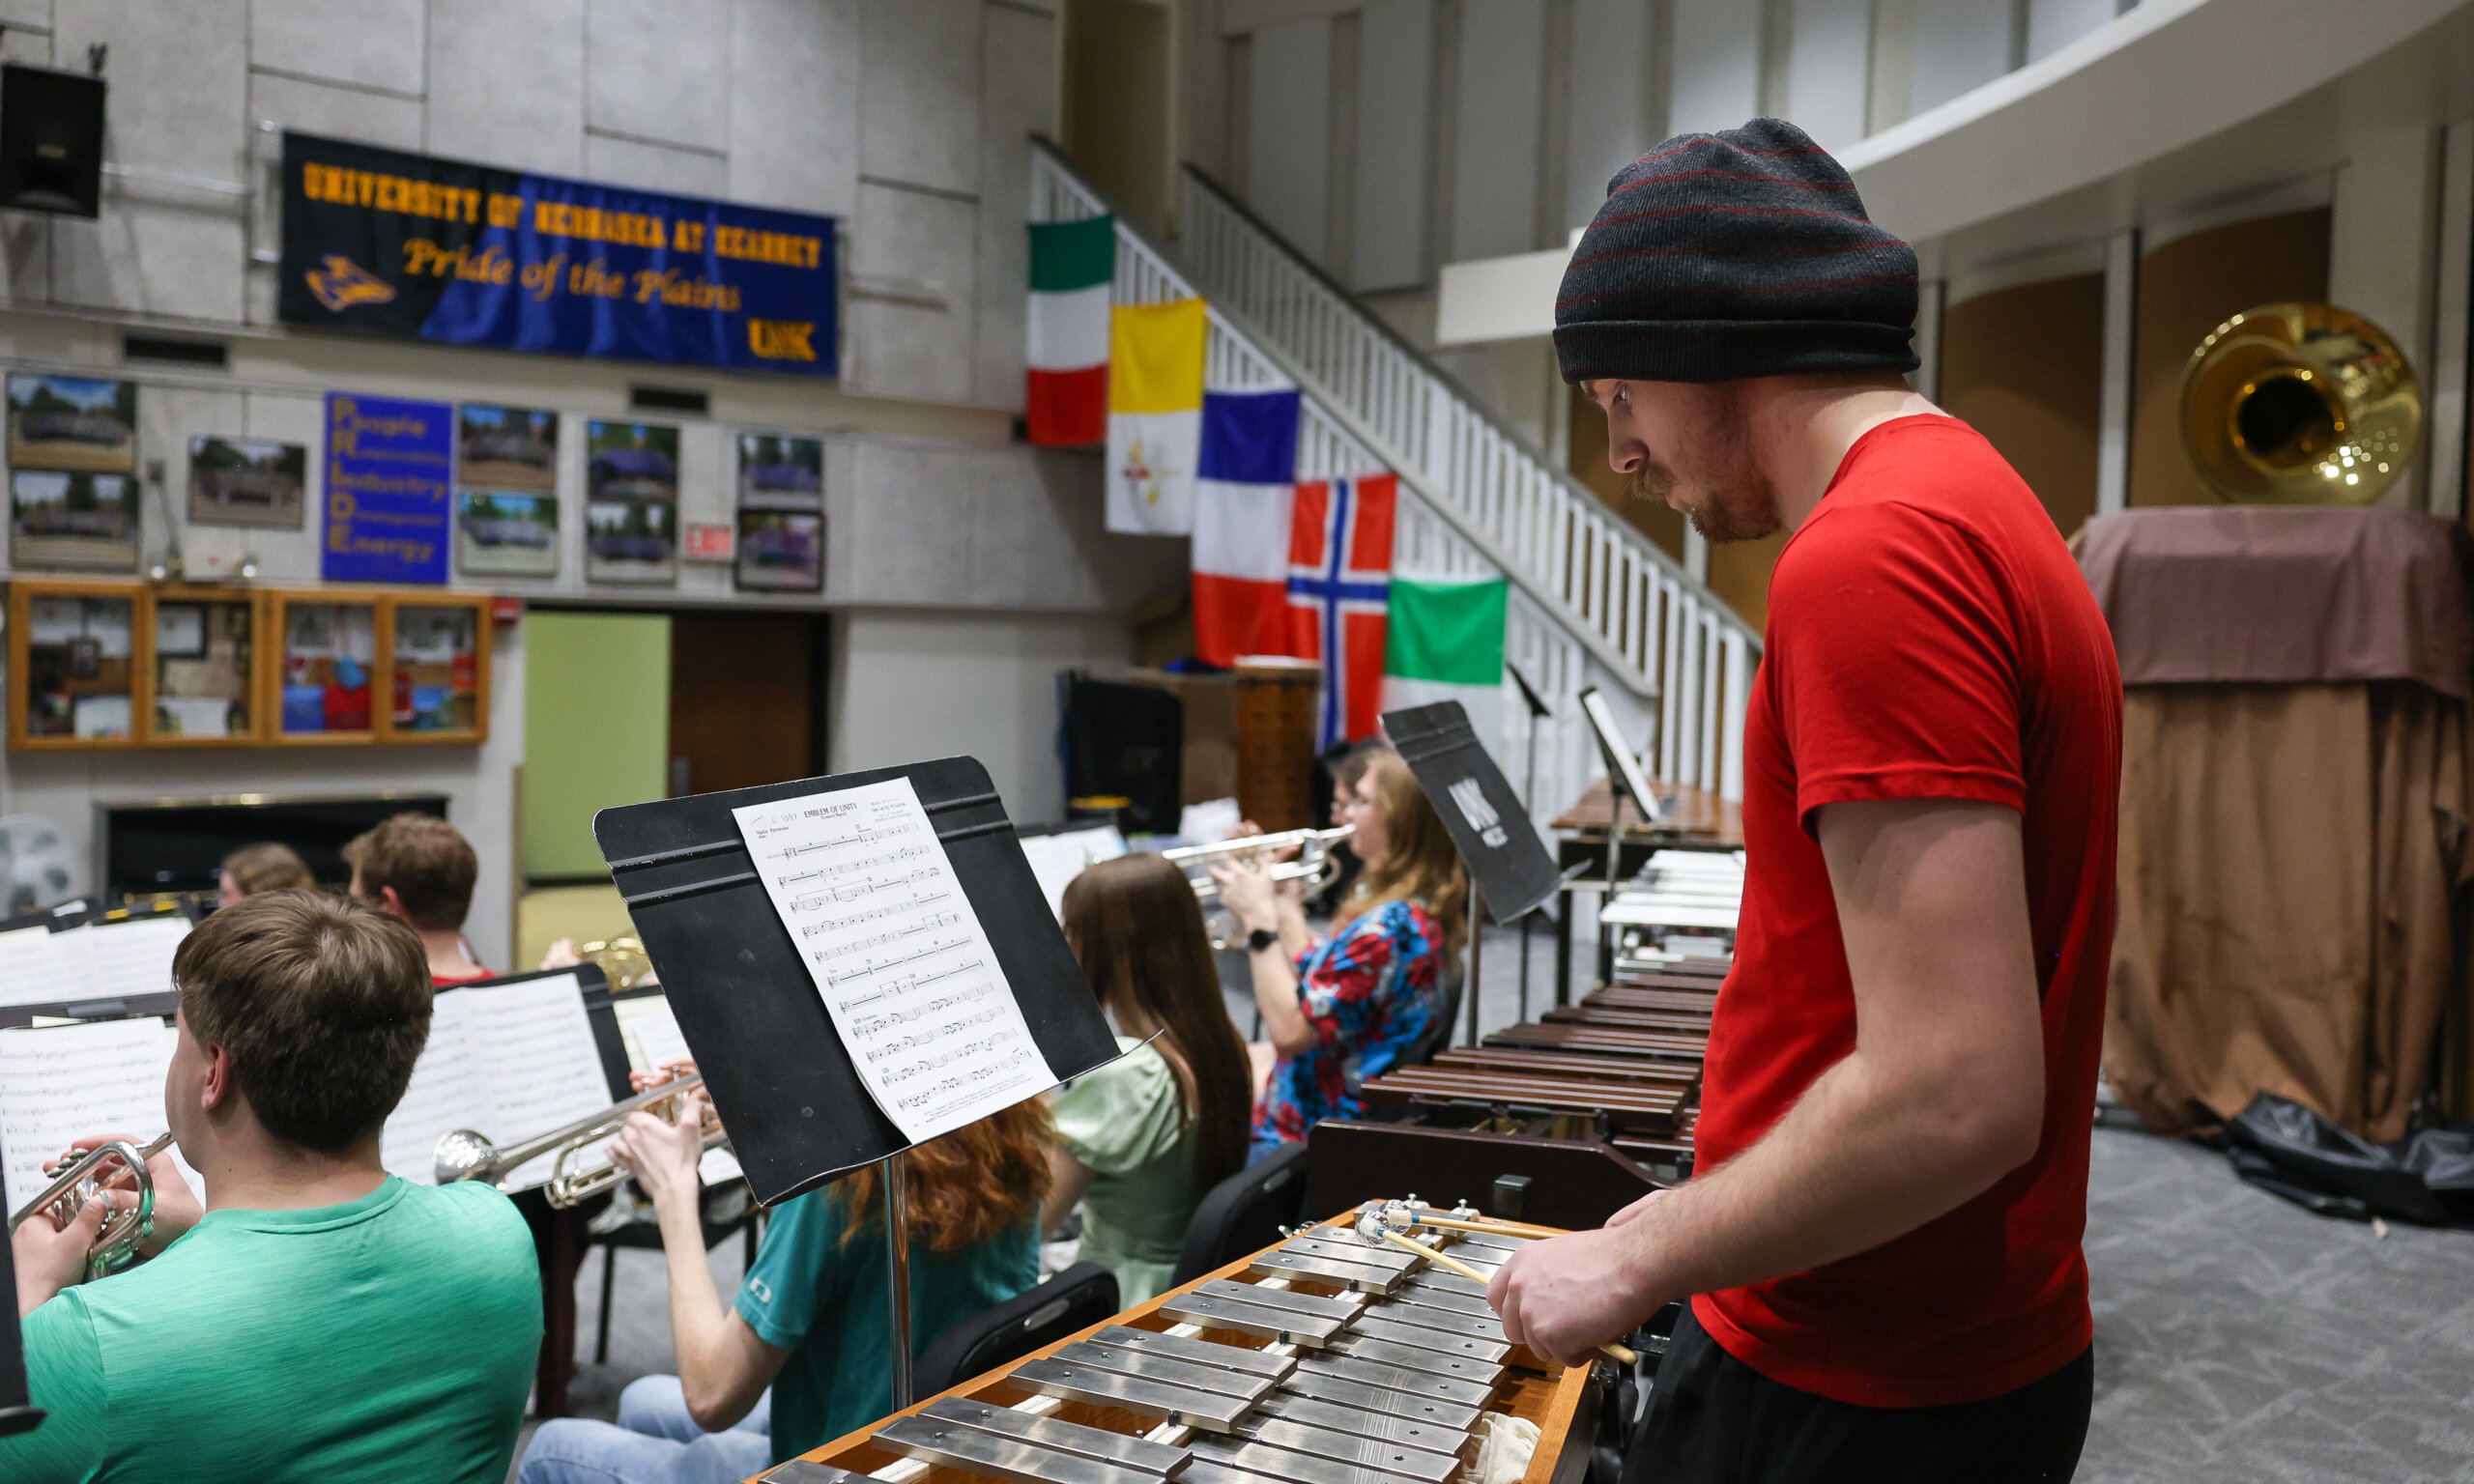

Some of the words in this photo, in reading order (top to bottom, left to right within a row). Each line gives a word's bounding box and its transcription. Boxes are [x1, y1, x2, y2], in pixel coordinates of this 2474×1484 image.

[303, 161, 481, 224] UNIVERSITY
[488, 193, 524, 230] OF
[674, 219, 705, 254] AT
[402, 238, 513, 285] Pride
[520, 253, 568, 301] of
[568, 257, 625, 299] the
[632, 267, 741, 312] Plains
[332, 397, 428, 438] People
[803, 807, 829, 818] EMBLEM
[830, 805, 838, 813] OF
[839, 802, 857, 813] UNITY
